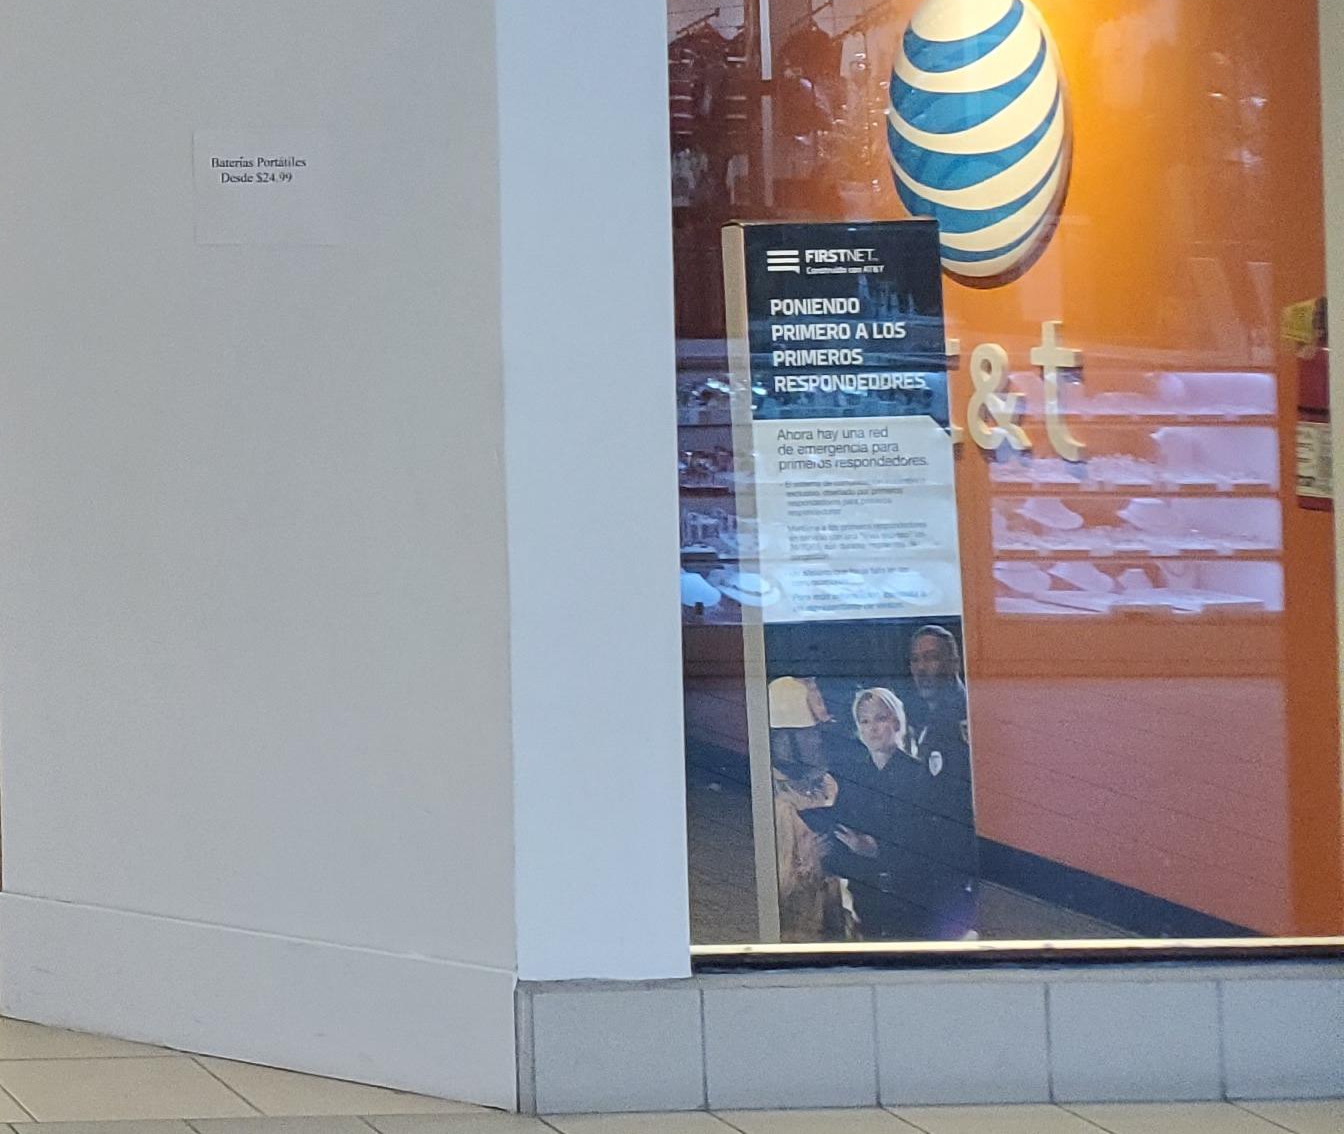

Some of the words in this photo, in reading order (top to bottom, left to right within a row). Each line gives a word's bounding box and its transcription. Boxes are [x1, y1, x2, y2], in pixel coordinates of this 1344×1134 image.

[221, 172, 254, 184] Desde
[805, 249, 877, 264] FIRSTNET
[770, 298, 860, 315] PONIENDO
[771, 323, 851, 341] PRIMERO
[855, 323, 869, 340] A
[872, 322, 907, 339] LOS
[773, 349, 863, 367] PRIMEROS
[777, 428, 813, 441] Ahora
[817, 428, 838, 442] hay
[842, 429, 864, 439] una
[868, 426, 888, 438] red
[777, 444, 794, 455] de
[797, 443, 868, 457] emergencia
[872, 443, 899, 455] para
